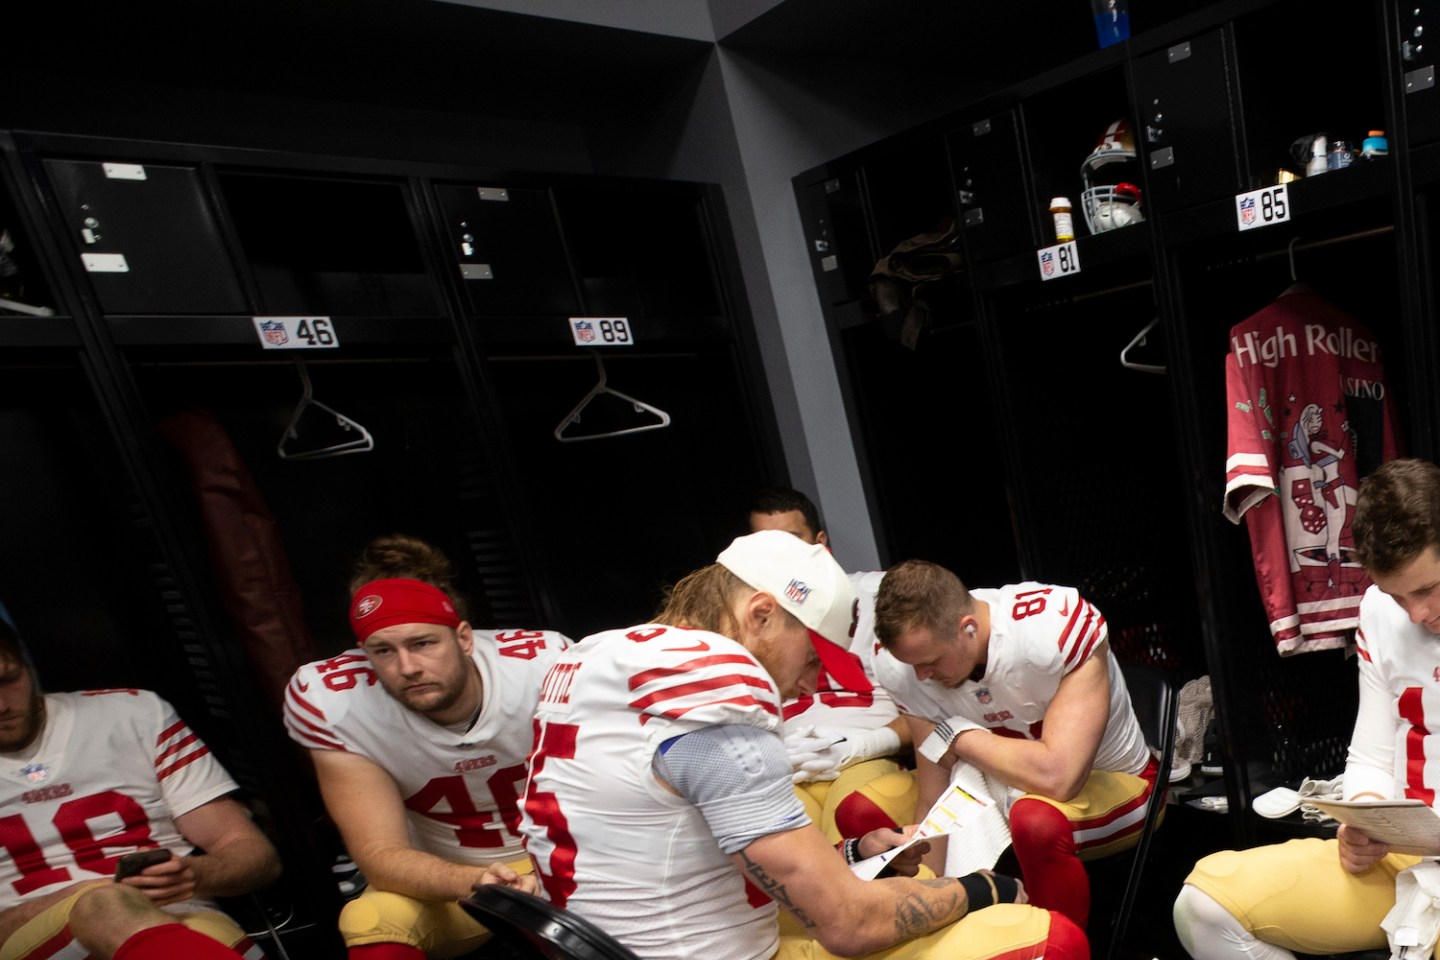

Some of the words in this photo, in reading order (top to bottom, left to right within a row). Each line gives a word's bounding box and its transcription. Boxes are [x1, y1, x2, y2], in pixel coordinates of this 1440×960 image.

[1261, 188, 1286, 222] 85
[1058, 245, 1076, 273] 81
[297, 319, 334, 345] 46
[600, 320, 629, 342] 89
[1232, 325, 1298, 368] High
[1305, 323, 1379, 362] Roller
[1012, 588, 1053, 621] 81
